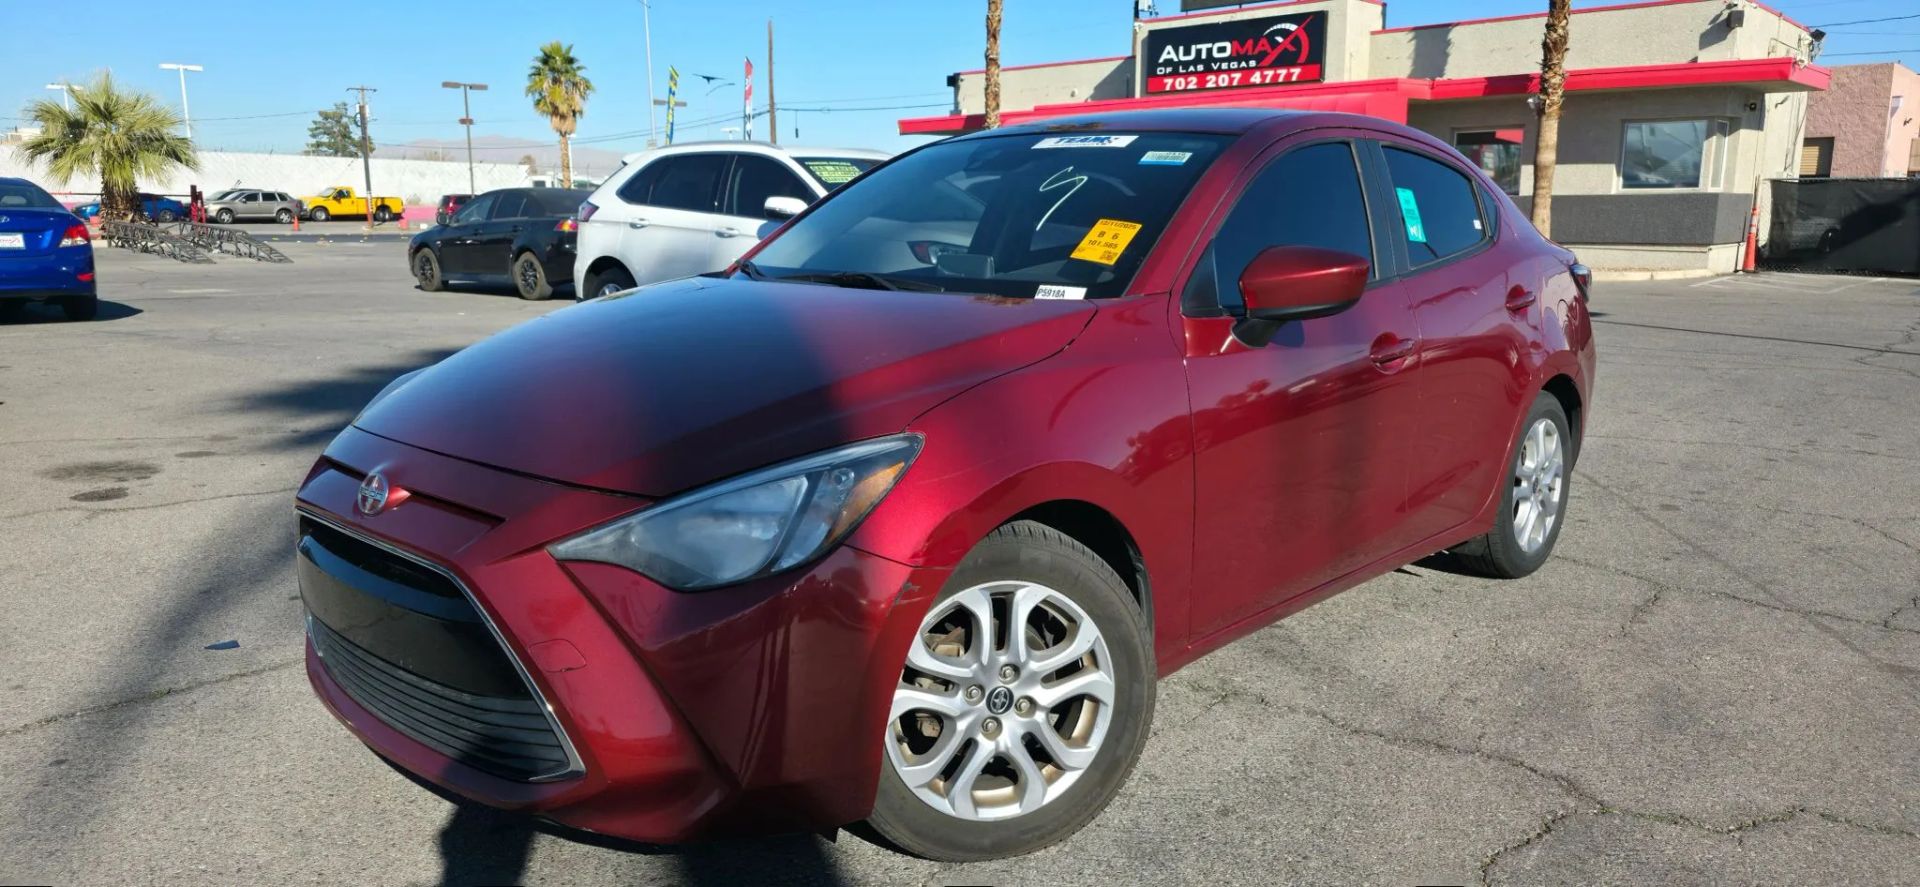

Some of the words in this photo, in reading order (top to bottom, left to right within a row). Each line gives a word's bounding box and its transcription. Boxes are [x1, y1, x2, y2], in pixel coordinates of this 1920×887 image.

[1158, 15, 1313, 67] AUTOMAX
[1157, 67, 1173, 75] OF
[1179, 63, 1204, 73] LAS
[1211, 60, 1257, 71] VEGAS
[1163, 77, 1197, 91] 702
[1206, 74, 1241, 88] 207
[1250, 68, 1302, 84] 4777
[1037, 289, 1065, 298] P5918A
